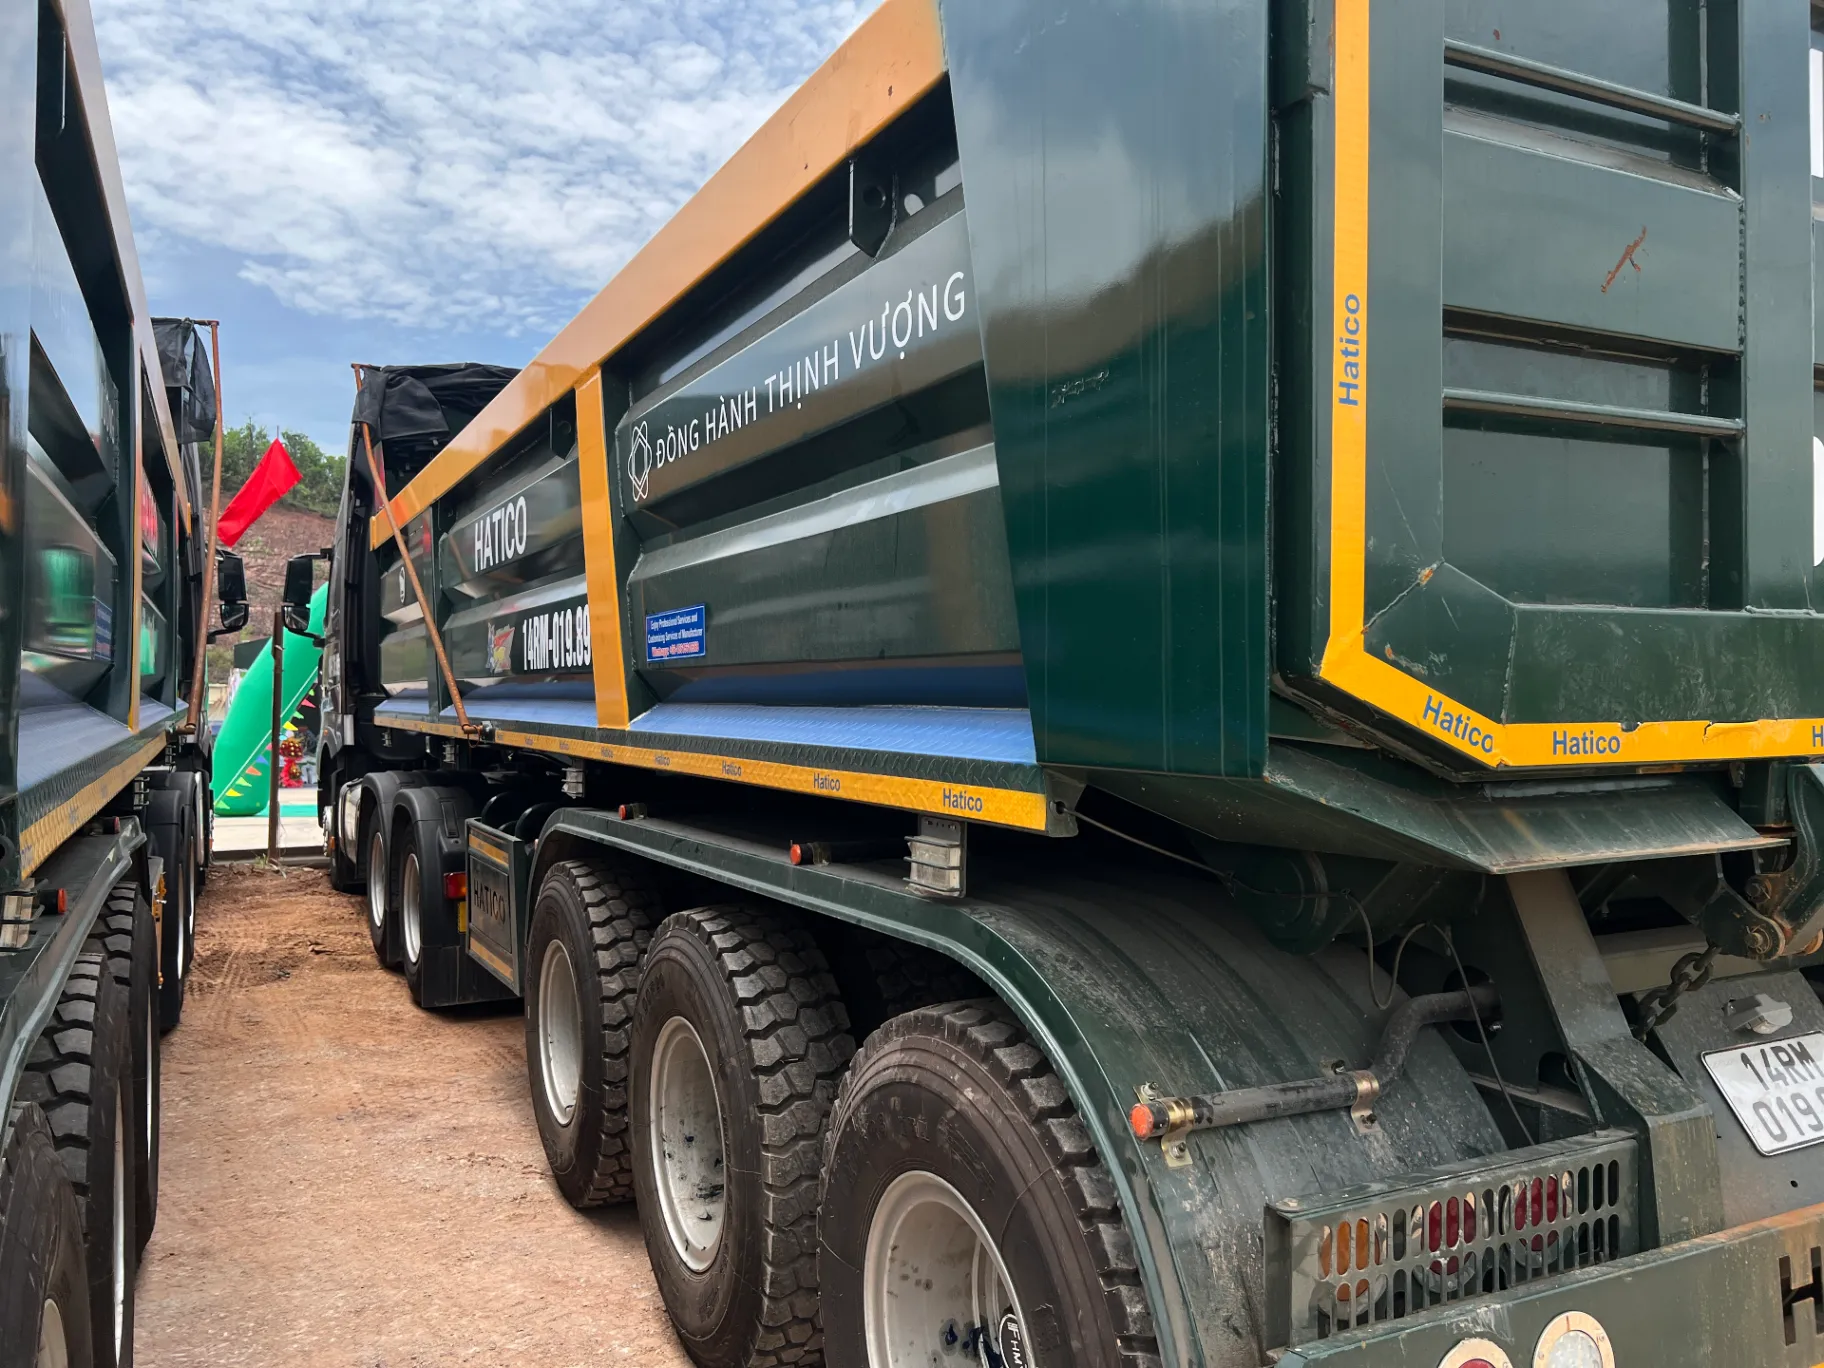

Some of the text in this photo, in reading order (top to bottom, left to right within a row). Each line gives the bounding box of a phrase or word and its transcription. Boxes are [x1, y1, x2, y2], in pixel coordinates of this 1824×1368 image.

[656, 271, 966, 468] ĐỒNG HÀNH THỊNH VƯỢNG
[1338, 293, 1360, 406] Hatico
[475, 496, 527, 572] HATICO
[522, 604, 591, 670] 14RM-019.89
[1423, 694, 1493, 753] Hatico
[1553, 731, 1620, 756] Hatico
[722, 759, 742, 777] Hatico
[813, 772, 840, 792] Hatico
[943, 788, 983, 813] Hatico
[474, 879, 506, 925] HATICO
[1741, 1041, 1824, 1091] 14RM
